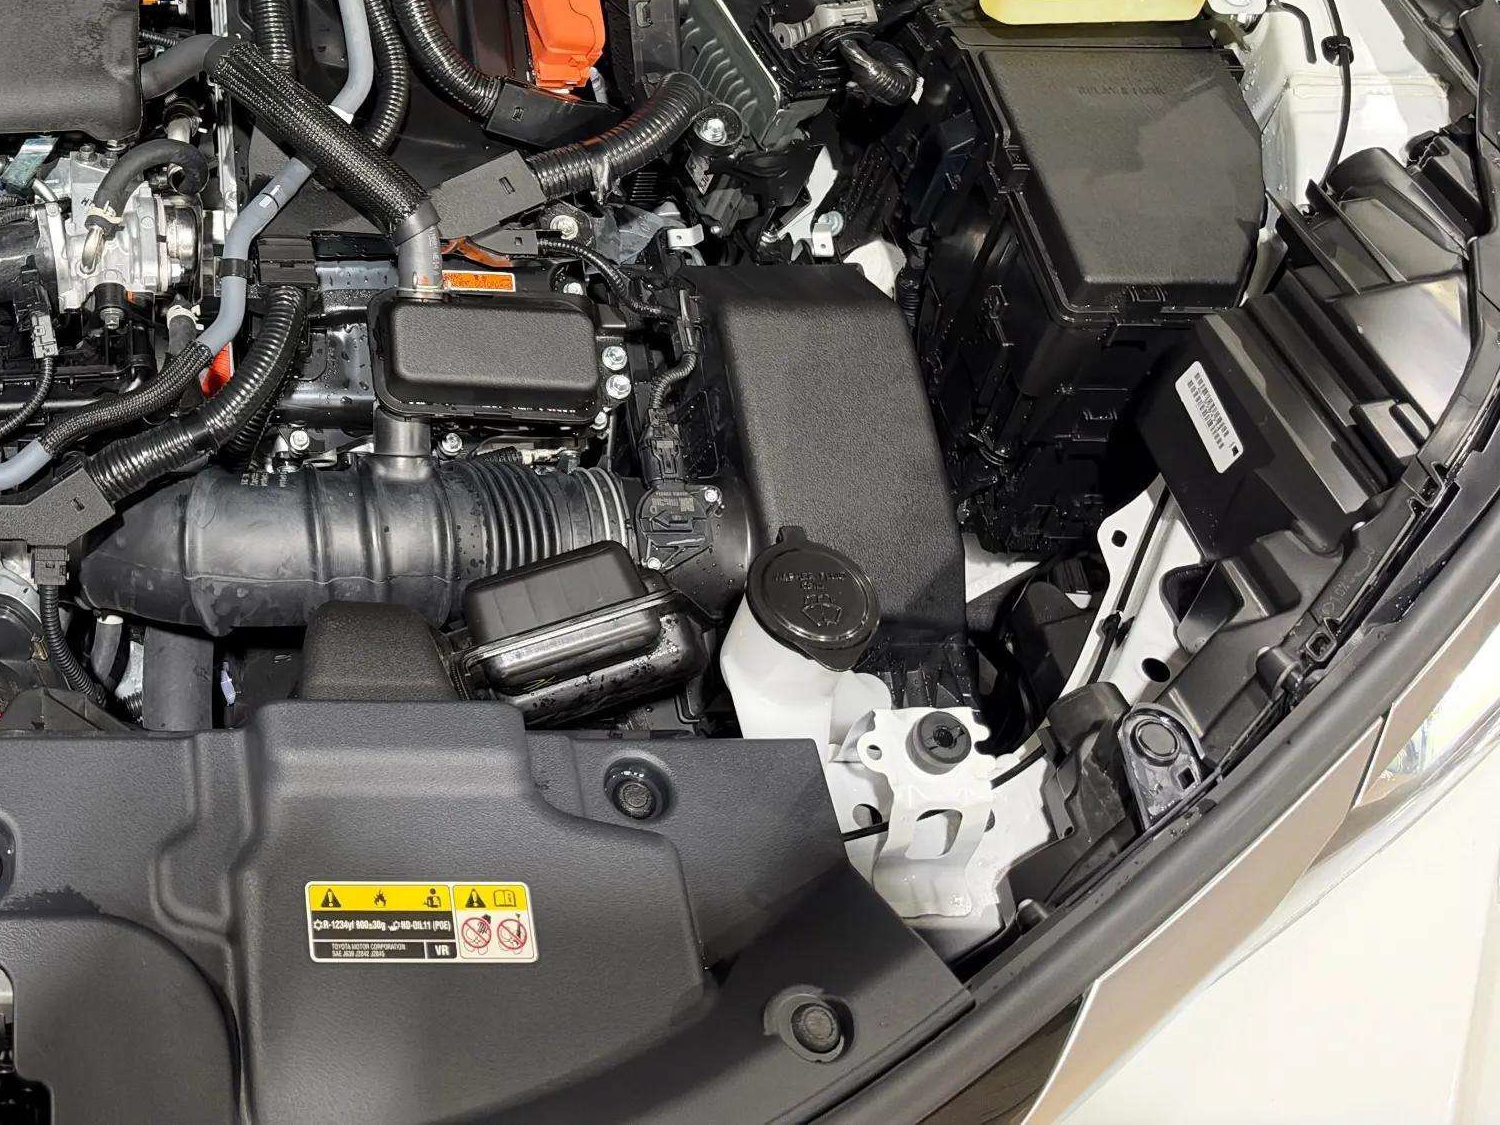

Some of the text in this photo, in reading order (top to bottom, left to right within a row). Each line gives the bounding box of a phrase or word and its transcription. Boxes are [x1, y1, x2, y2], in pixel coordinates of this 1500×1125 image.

[332, 943, 351, 951] TOYOTA
[370, 943, 406, 951] CORPORATION
[434, 944, 451, 956] VR
